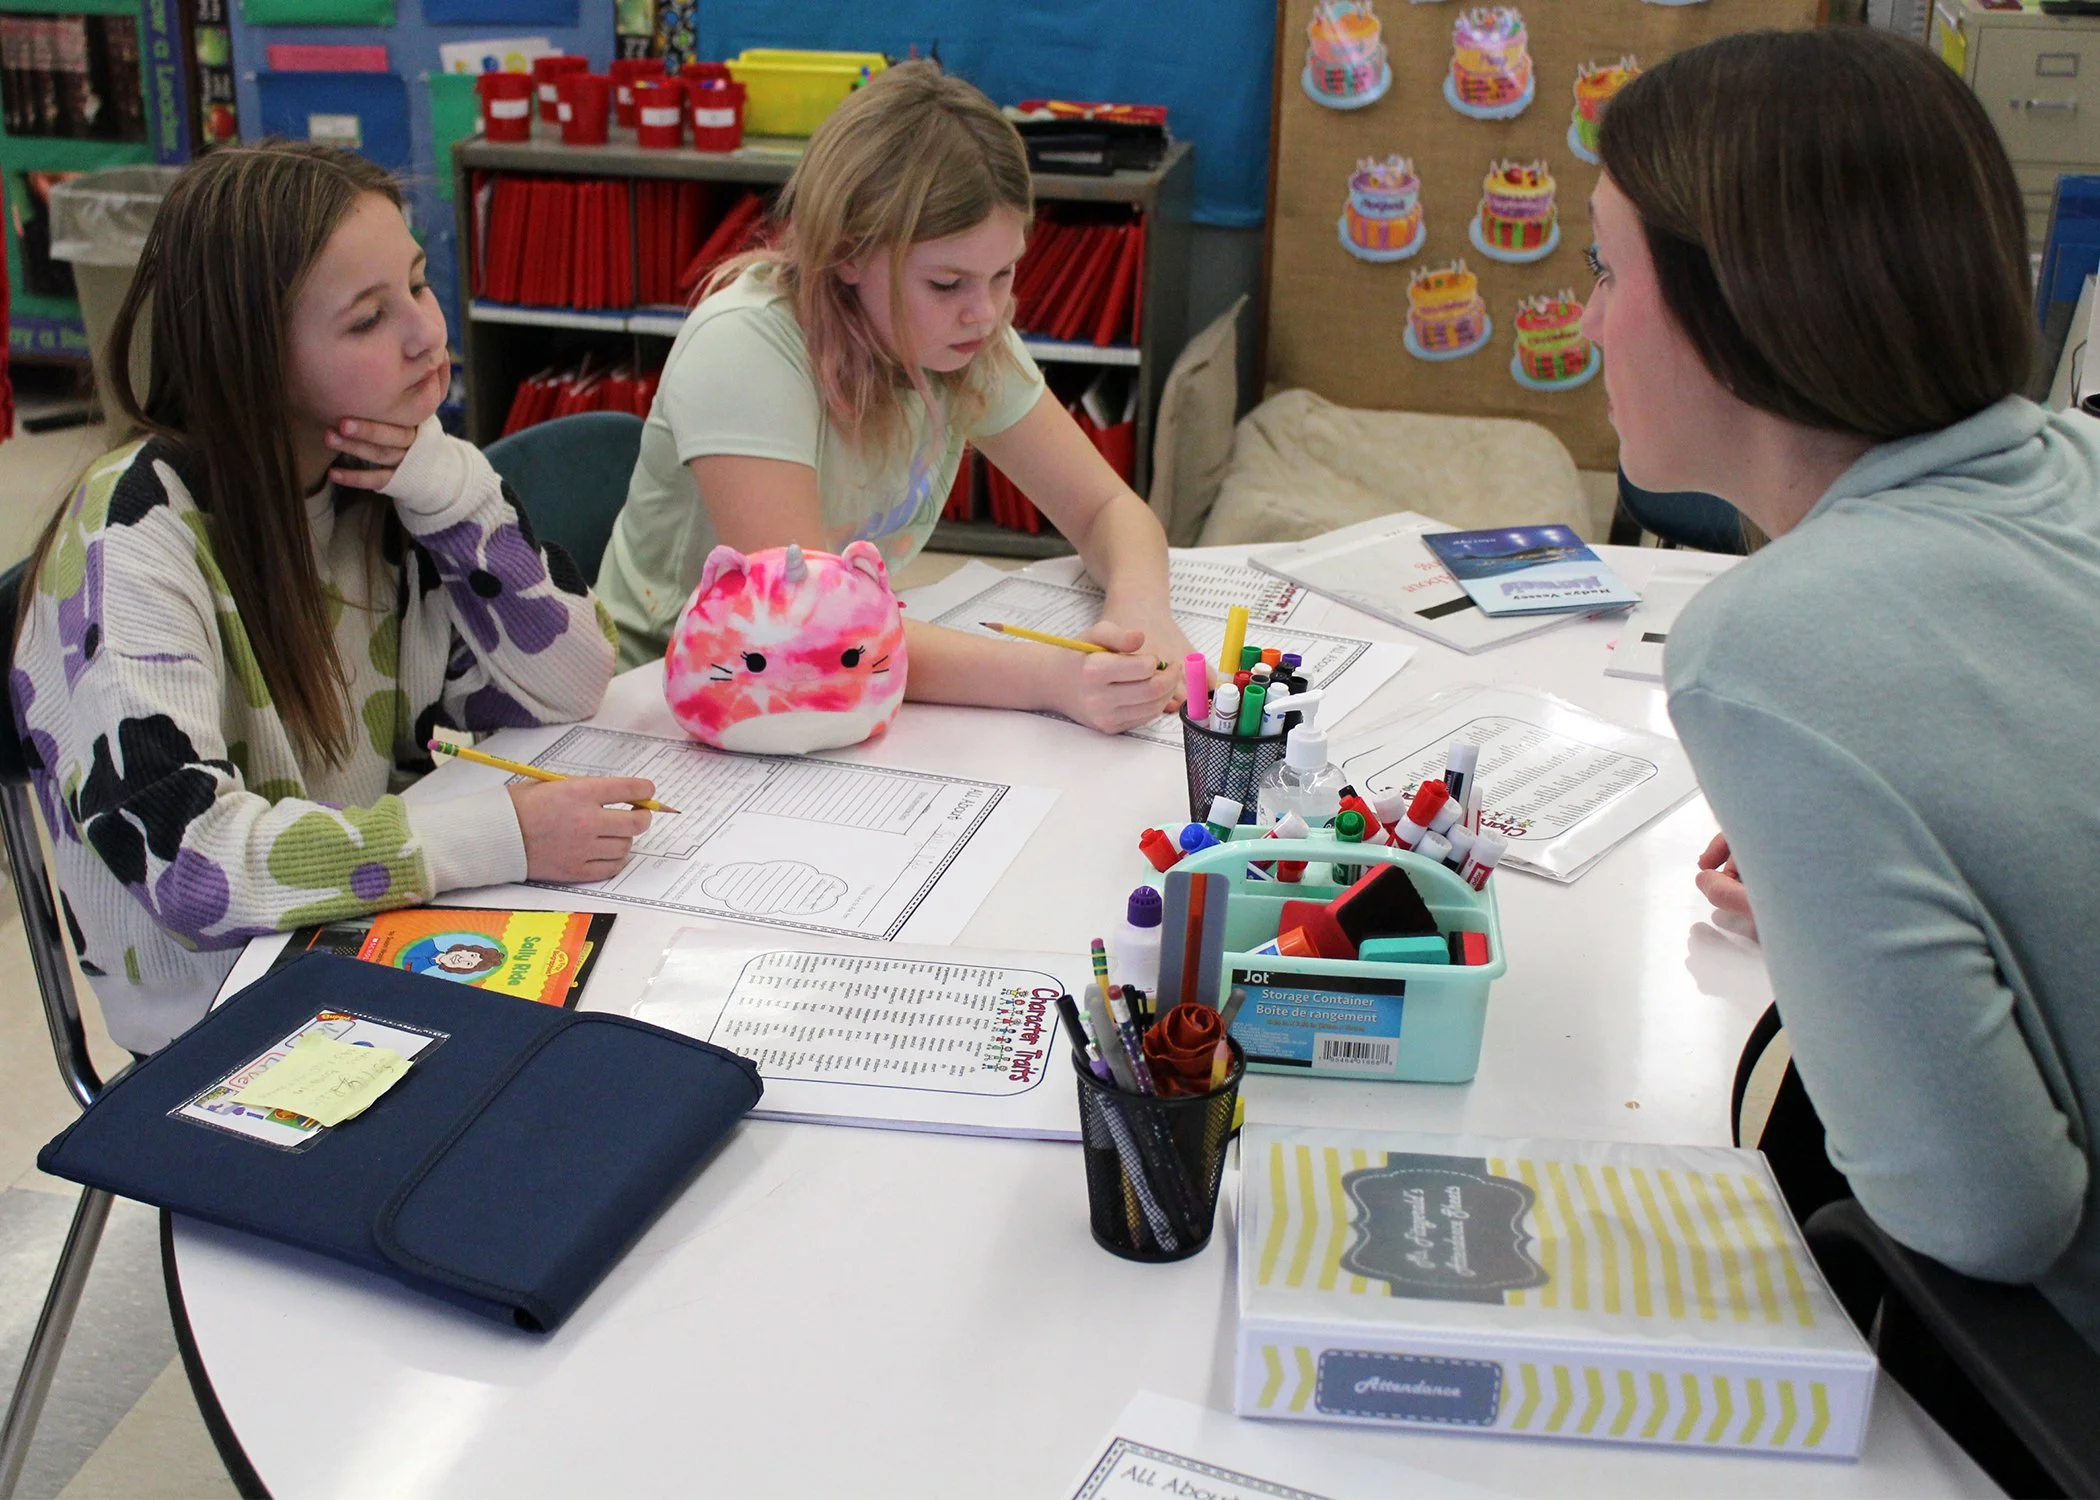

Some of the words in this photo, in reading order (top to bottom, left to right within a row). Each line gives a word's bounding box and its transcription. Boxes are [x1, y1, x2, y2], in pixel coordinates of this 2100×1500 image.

[512, 936, 542, 961] Sally
[507, 963, 532, 986] Ride
[1243, 970, 1270, 985] Jot
[1262, 989, 1310, 1003] Storage
[1313, 993, 1375, 1007] Container
[1019, 987, 1060, 1046] Character
[1256, 1004, 1289, 1017] Boîte
[1292, 1007, 1306, 1018] de
[1310, 1011, 1377, 1023] rangement
[1008, 1050, 1043, 1083] Traits
[1354, 1375, 1461, 1398] Attendance
